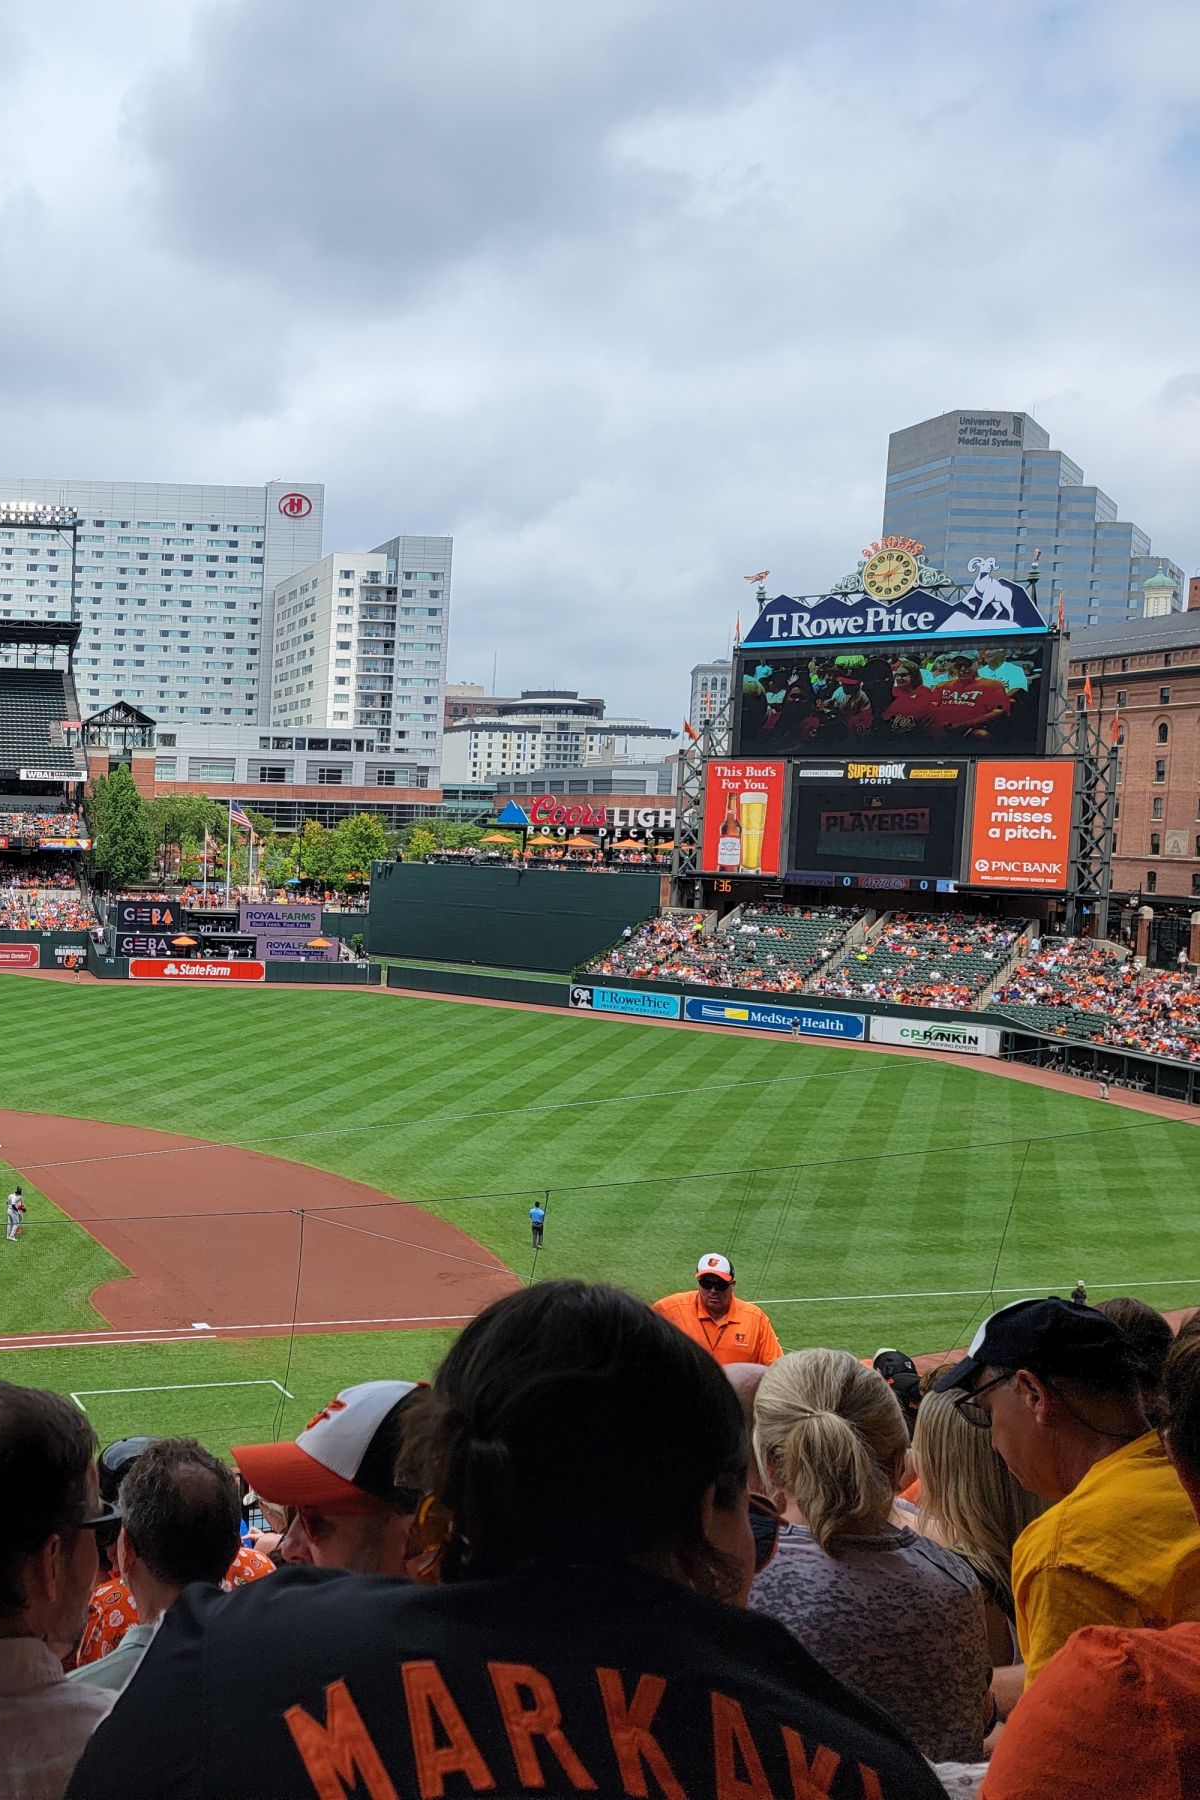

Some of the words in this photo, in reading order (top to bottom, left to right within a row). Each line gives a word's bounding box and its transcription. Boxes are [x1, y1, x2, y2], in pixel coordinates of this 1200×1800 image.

[959, 416, 1001, 427] University
[958, 426, 968, 436] of
[969, 427, 1008, 437] Maryland
[957, 436, 990, 446] Medical
[991, 437, 1021, 447] System
[27, 770, 55, 780] WBAL
[714, 766, 743, 777] This
[745, 766, 777, 777] Bud's
[847, 763, 907, 780] SUPERBOOK
[721, 778, 741, 790] For
[743, 778, 769, 790] You.
[993, 776, 1054, 794] Boring
[996, 795, 1050, 807] never
[529, 794, 608, 827] Coors
[990, 808, 1053, 823] misses
[527, 825, 581, 836] ROOF
[598, 827, 654, 838] DECK
[988, 827, 1001, 838] a
[1004, 824, 1057, 842] pitch.
[991, 861, 1022, 872] PNC
[1022, 862, 1063, 874] BANK
[713, 880, 732, 892] 1:36
[842, 877, 851, 887] 0
[919, 880, 929, 890] 0
[122, 937, 168, 950] GEBA
[54, 948, 87, 956] CHAMPIONS
[802, 1017, 844, 1031] Health
[900, 1028, 919, 1039] CP
[922, 1029, 979, 1046] RANKIN
[930, 1041, 954, 1049] ROOFING
